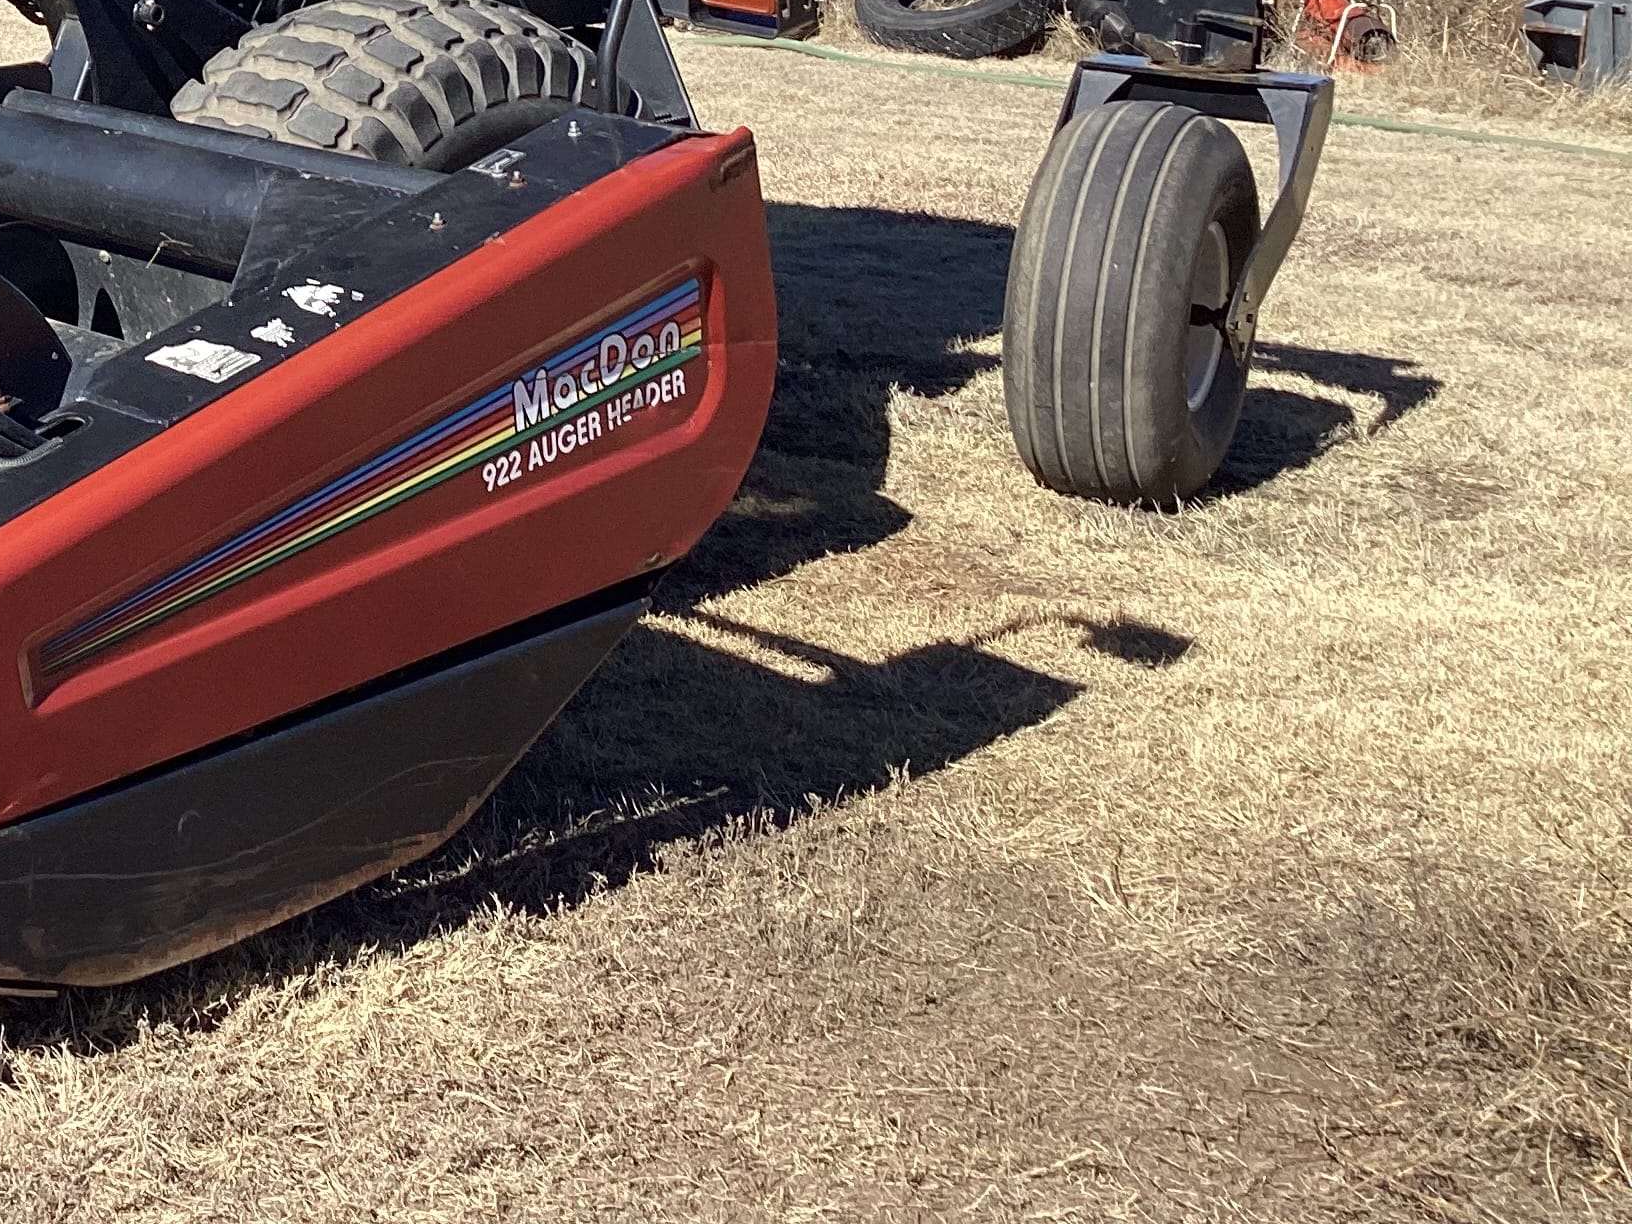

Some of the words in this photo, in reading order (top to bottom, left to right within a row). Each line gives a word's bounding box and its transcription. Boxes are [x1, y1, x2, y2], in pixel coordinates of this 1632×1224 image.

[482, 450, 523, 492] 922
[528, 411, 602, 472] AUGER
[607, 368, 686, 431] HEADER
[514, 322, 680, 432] MacDon
